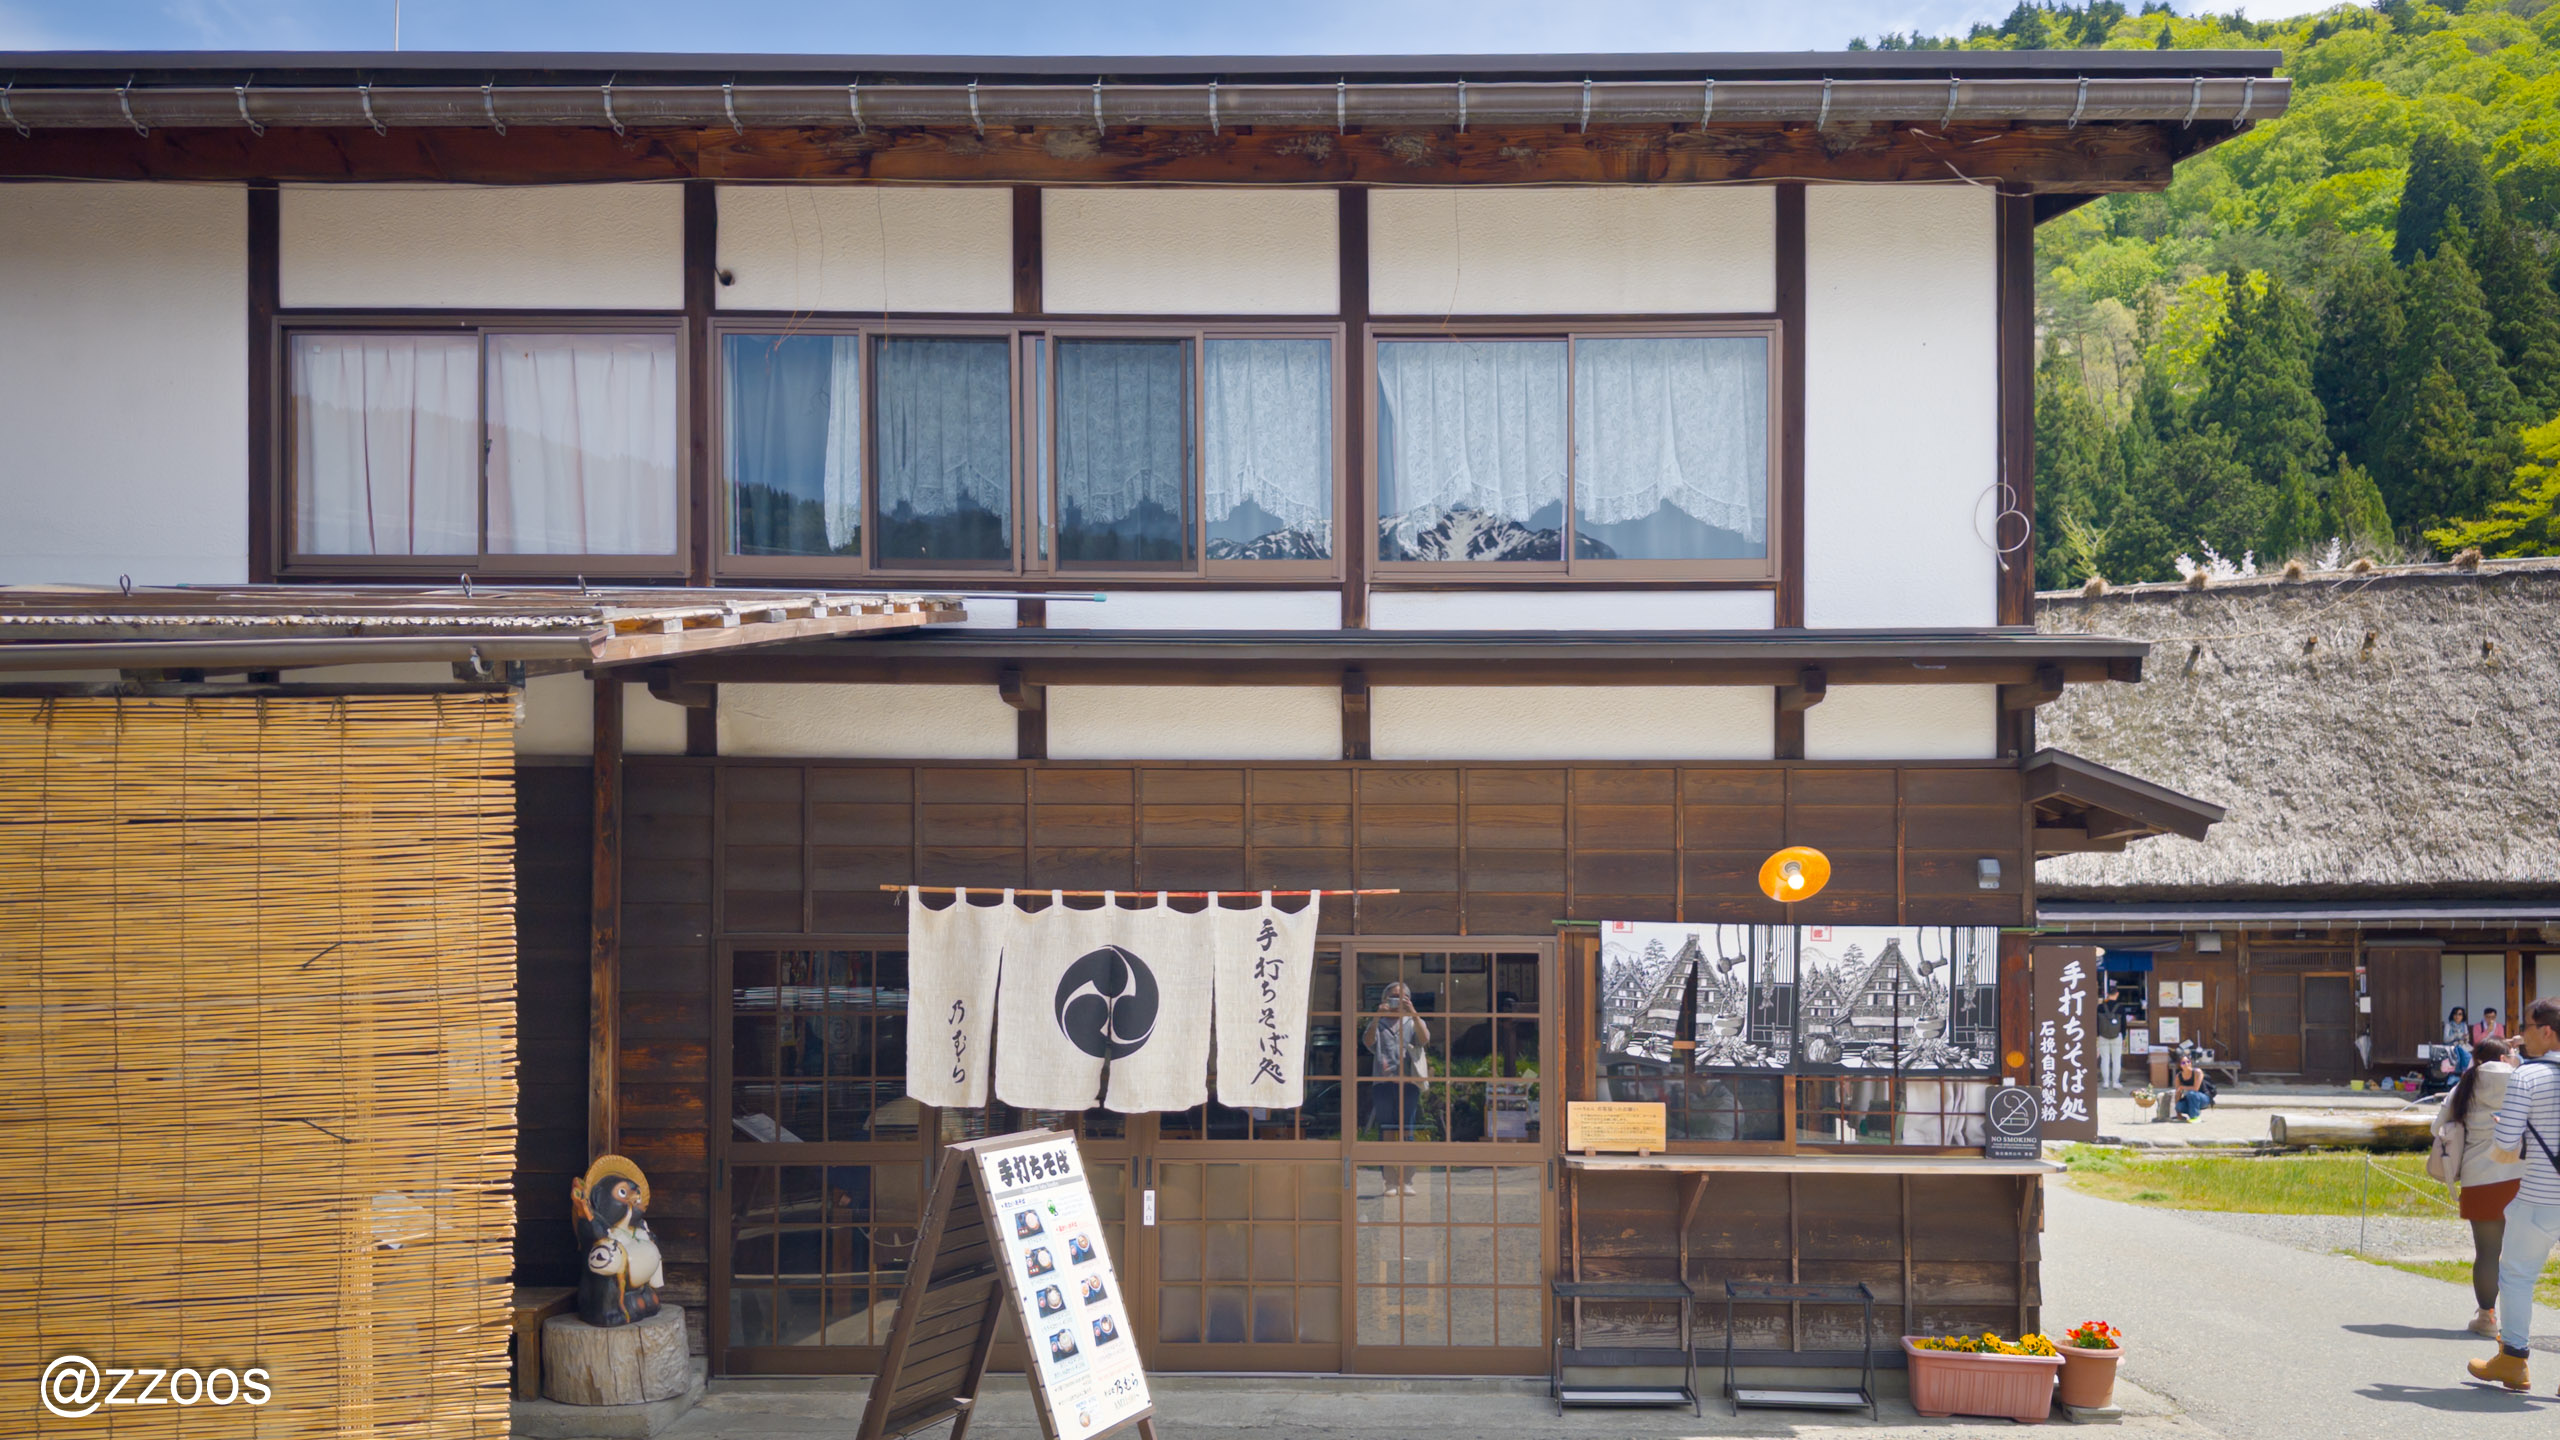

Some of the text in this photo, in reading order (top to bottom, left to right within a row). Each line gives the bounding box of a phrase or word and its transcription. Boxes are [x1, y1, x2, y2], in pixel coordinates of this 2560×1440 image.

[948, 999, 967, 1084] 乃むら
[1250, 918, 1289, 1085] 手打ちそば処
[2058, 960, 2090, 1122] 手打ちそば処
[2039, 1020, 2058, 1122] 石挽自家製粉
[997, 1149, 1071, 1188] 手打ちそば
